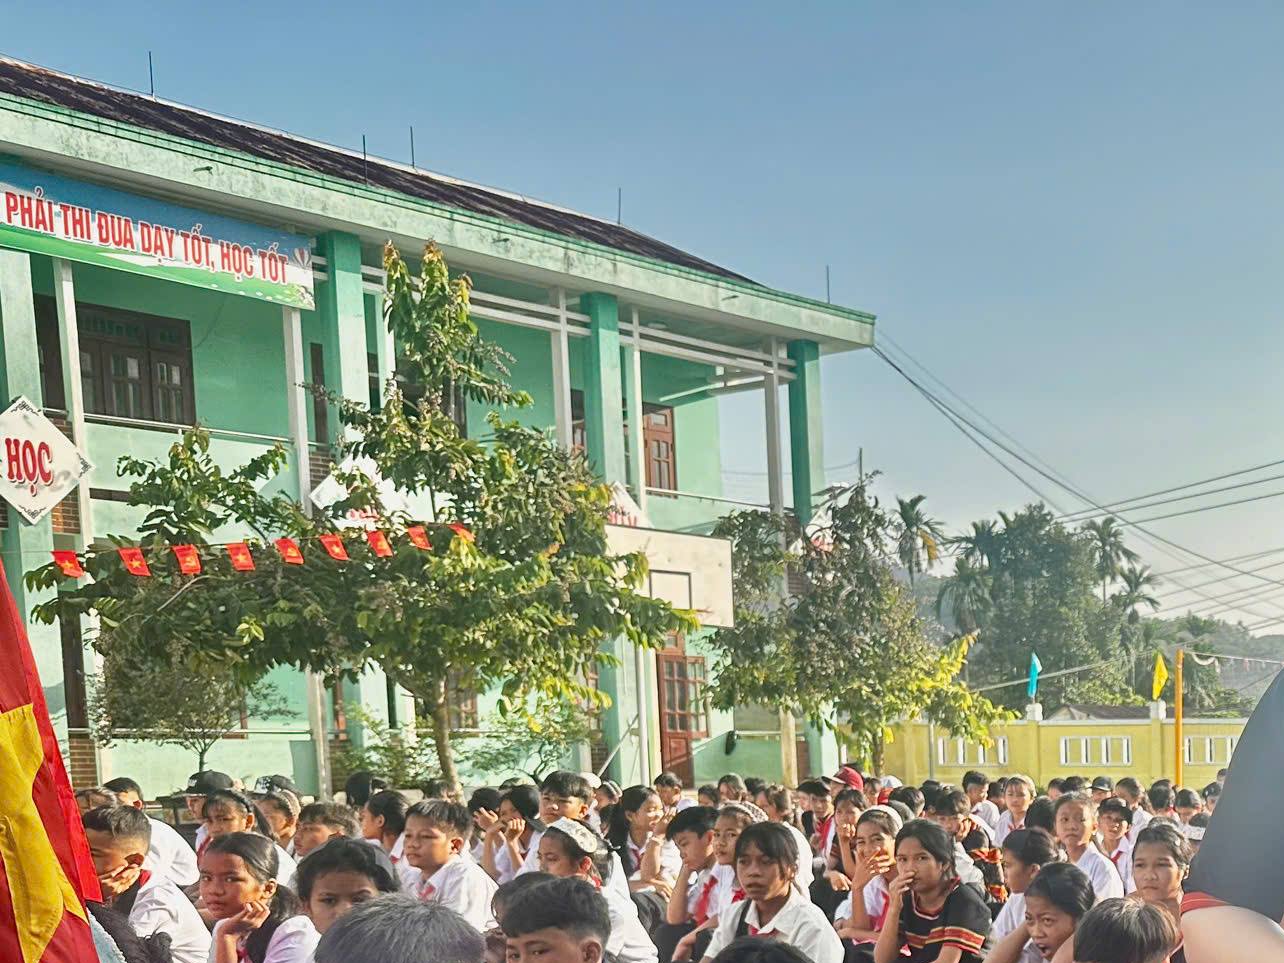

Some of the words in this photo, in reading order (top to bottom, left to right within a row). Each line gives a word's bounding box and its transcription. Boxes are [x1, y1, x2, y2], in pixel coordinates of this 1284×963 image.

[5, 187, 54, 232] PHẢI
[60, 204, 91, 240] THI
[97, 212, 135, 250] ĐUA
[140, 222, 175, 263] DẠY
[181, 224, 216, 271] TỐT,
[221, 242, 254, 280] HỌC
[258, 243, 288, 284] TỐT
[5, 438, 53, 495] HỌC
